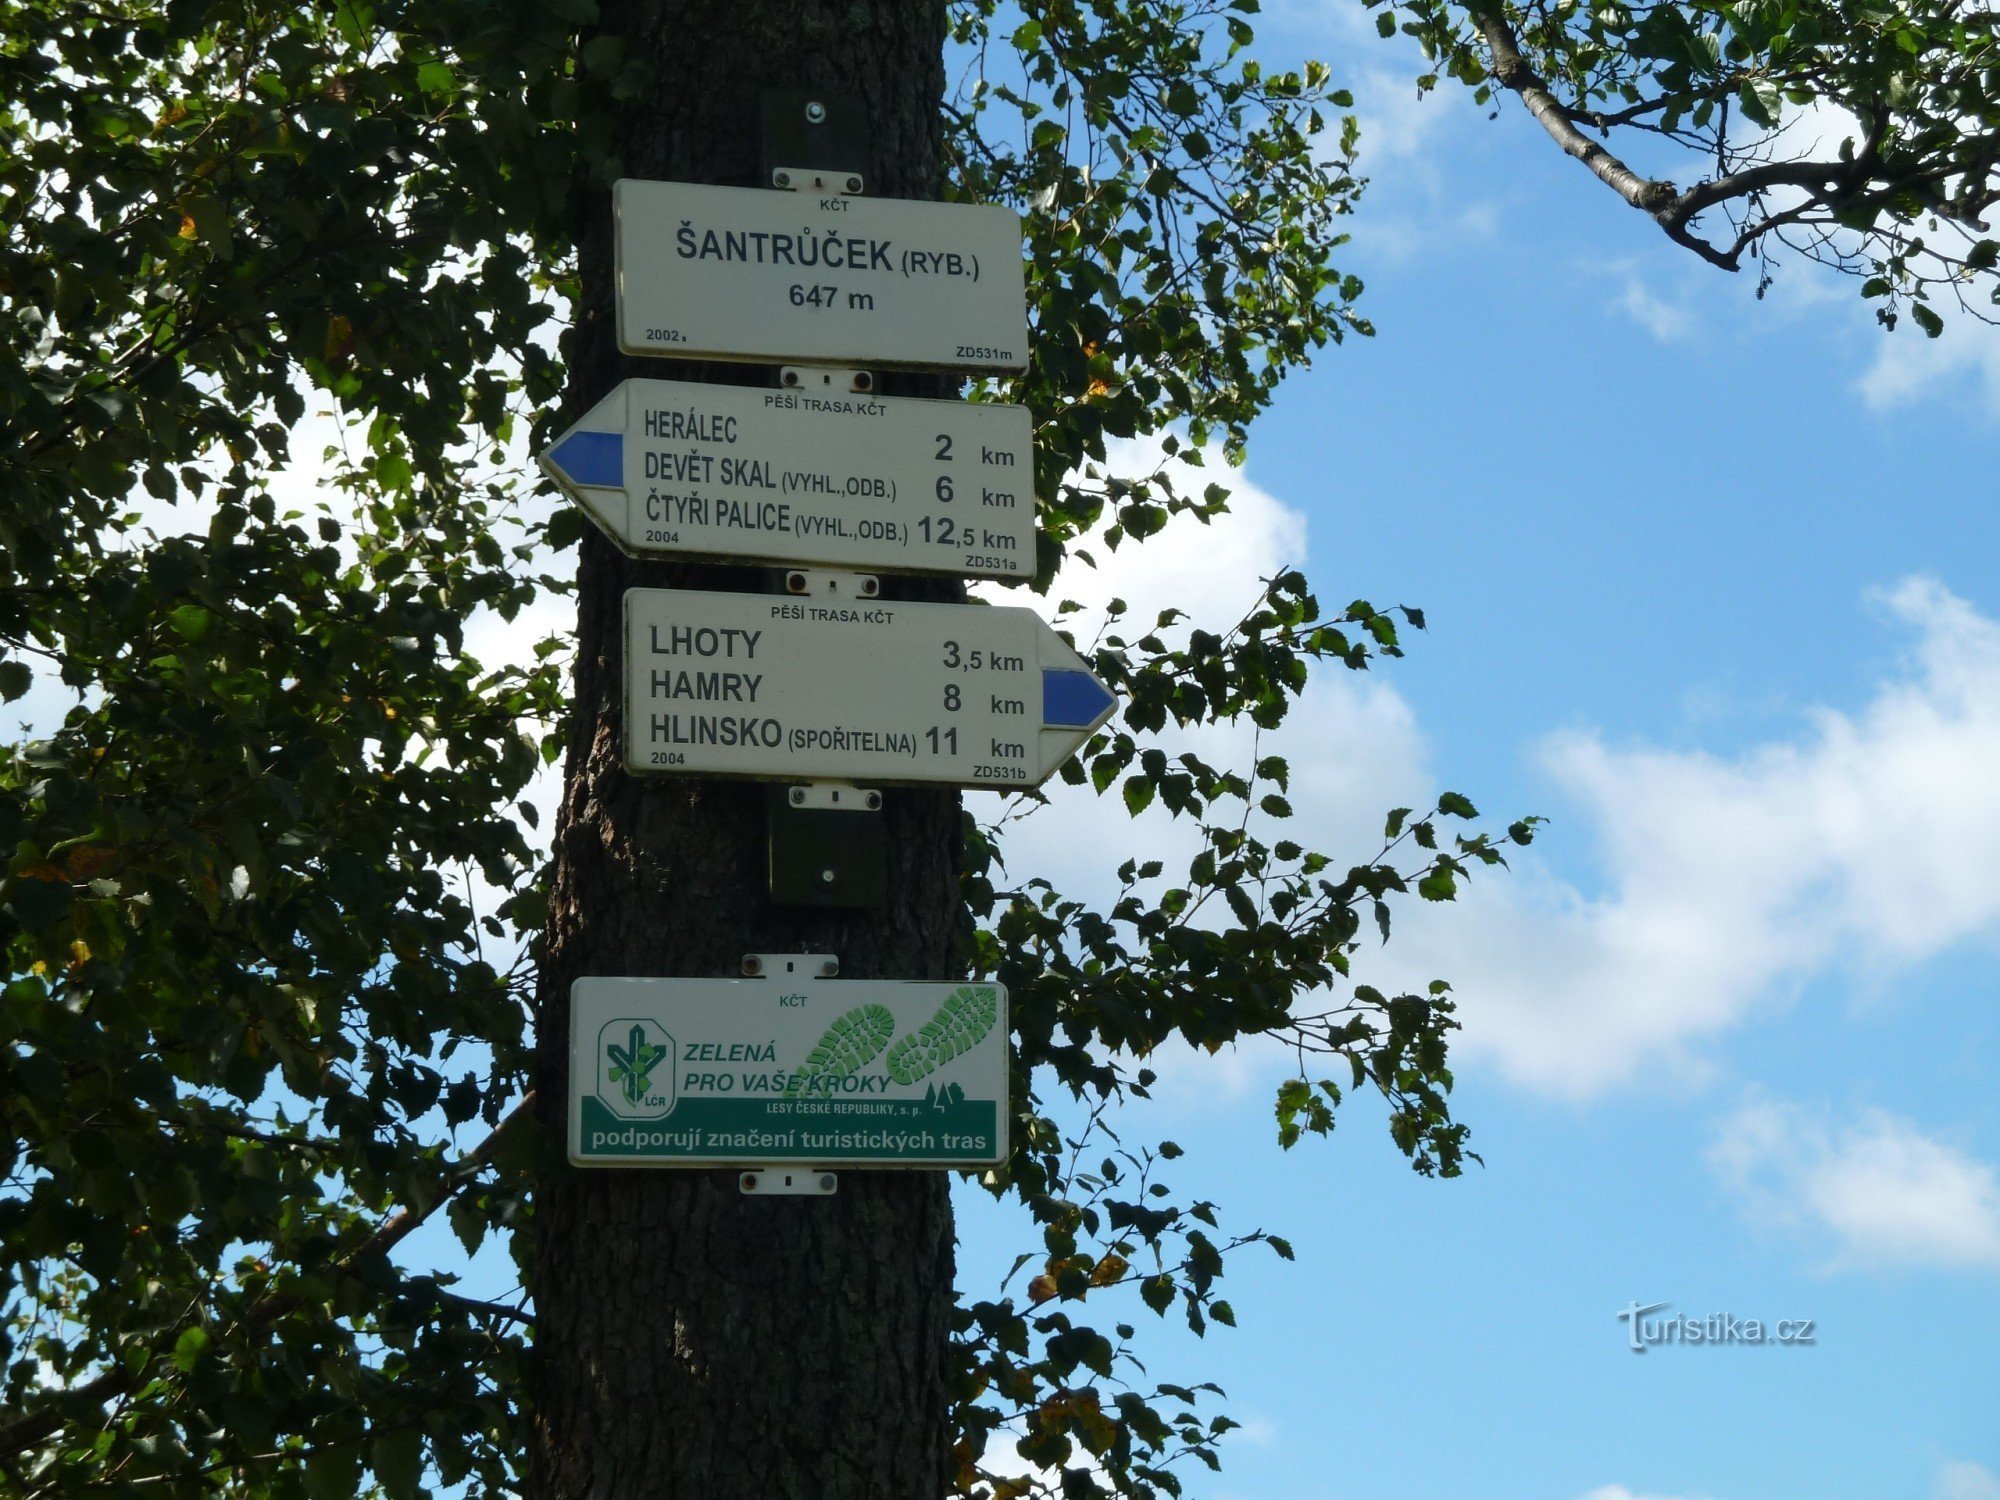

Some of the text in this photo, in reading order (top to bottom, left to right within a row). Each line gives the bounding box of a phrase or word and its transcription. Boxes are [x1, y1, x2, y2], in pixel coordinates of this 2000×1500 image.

[820, 198, 849, 213] KČT
[676, 220, 980, 282] ŠANTRŮČEK (RYB.)
[789, 284, 874, 310] 647 m
[956, 346, 1012, 360] ZD531m
[764, 395, 887, 417] PĚŠÍ TRASA KČT
[645, 408, 1015, 466] HERÁLEC 2 km
[645, 450, 714, 484] DEVĚT
[721, 459, 777, 489] SKAL
[936, 476, 954, 503] 6
[982, 488, 1015, 507] km
[646, 488, 709, 525] ČTYŘI
[716, 499, 790, 532] PALICE
[918, 516, 975, 548] 12,5
[983, 530, 1016, 549] km
[646, 530, 679, 544] 2004
[965, 555, 1017, 570] ZD531a
[771, 606, 894, 624] PĚŠÍ TRASA KČT
[651, 626, 1023, 672] LHOTY 3,5 km
[651, 670, 1024, 715] HAMRY 8 km
[651, 714, 1024, 758] HLINSKO (SPOŘITELNA) 11 km
[651, 752, 685, 765] 2004
[973, 765, 1026, 780] ZD531b
[780, 994, 808, 1008] KČT
[683, 1040, 777, 1062] ZELENÁ
[683, 1069, 893, 1094] PRO VAŠE KROKY
[766, 1102, 793, 1114] LESY
[795, 1099, 831, 1115] ČESKÉ
[834, 1103, 898, 1116] REPUBLIKY,
[592, 1128, 987, 1153] podporují značení turistických tras
